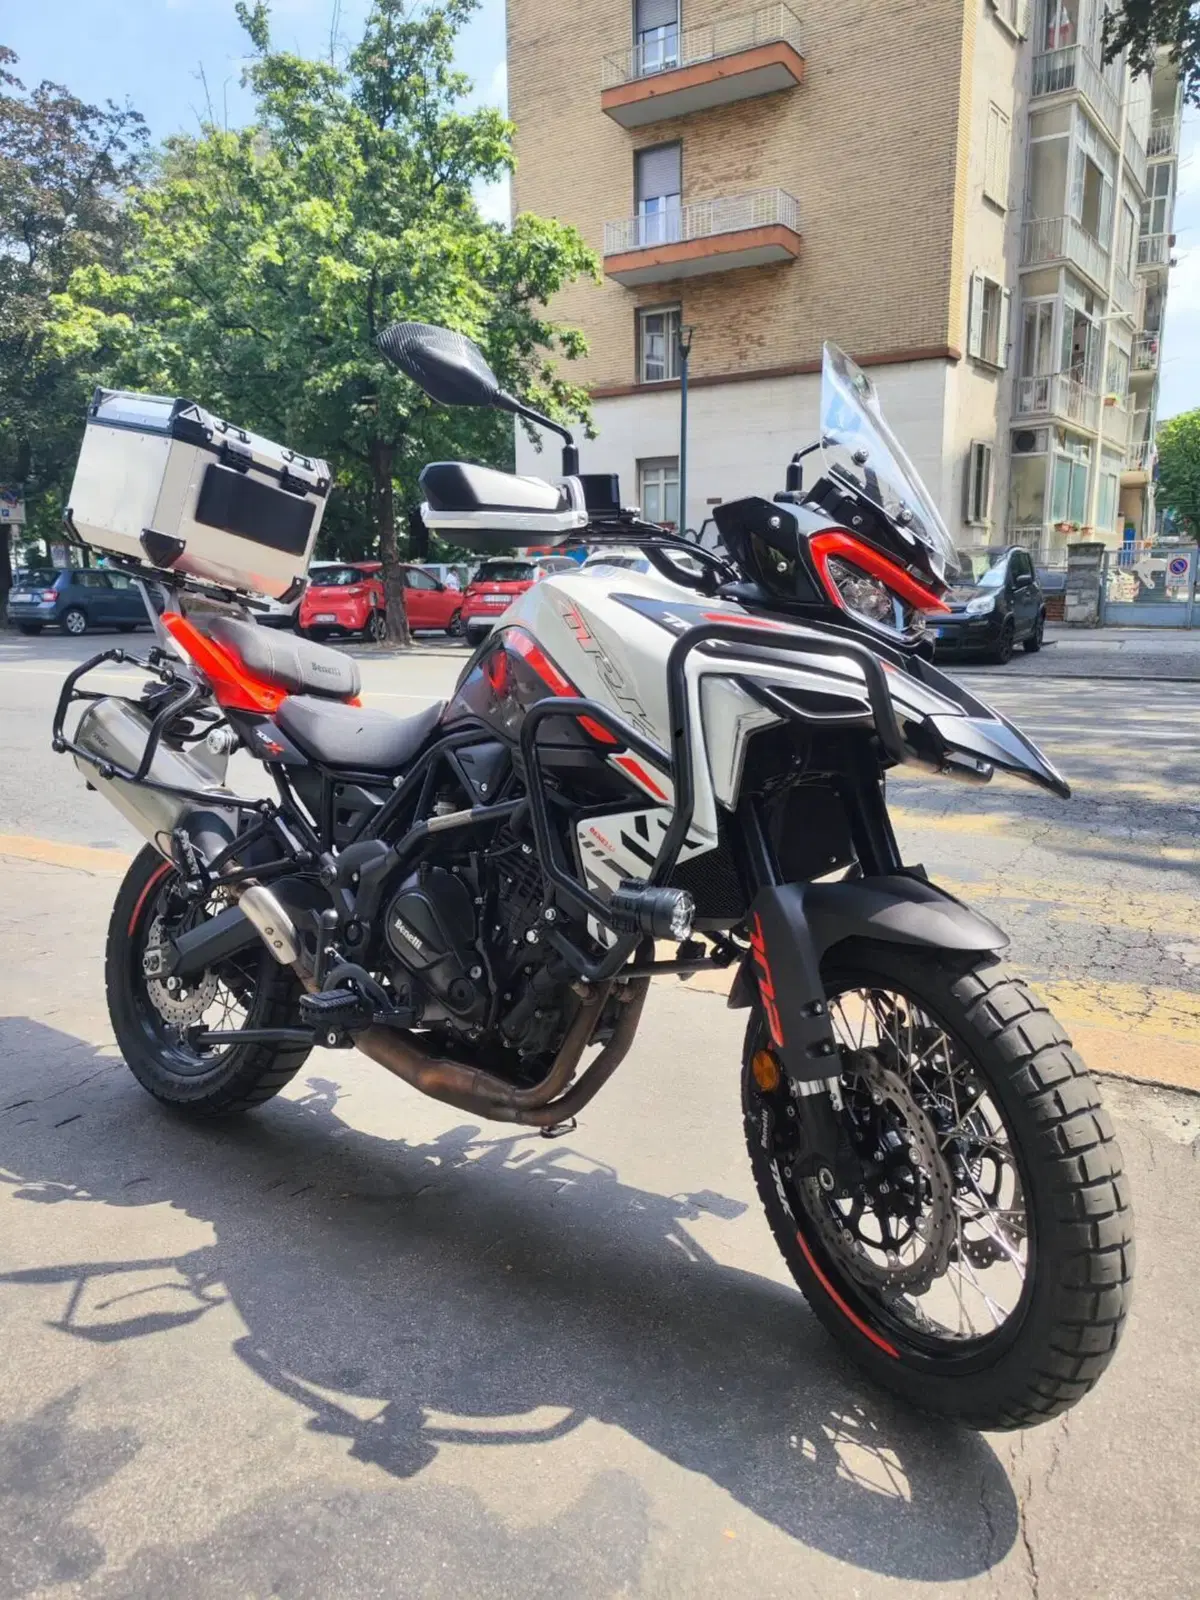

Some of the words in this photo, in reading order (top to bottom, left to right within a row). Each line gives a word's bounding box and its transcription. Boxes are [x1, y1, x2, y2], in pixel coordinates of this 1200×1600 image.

[311, 661, 342, 677] Benelli
[394, 917, 423, 950] Benelli
[760, 1108, 769, 1149] Benelli
[769, 1157, 796, 1221] TRK
